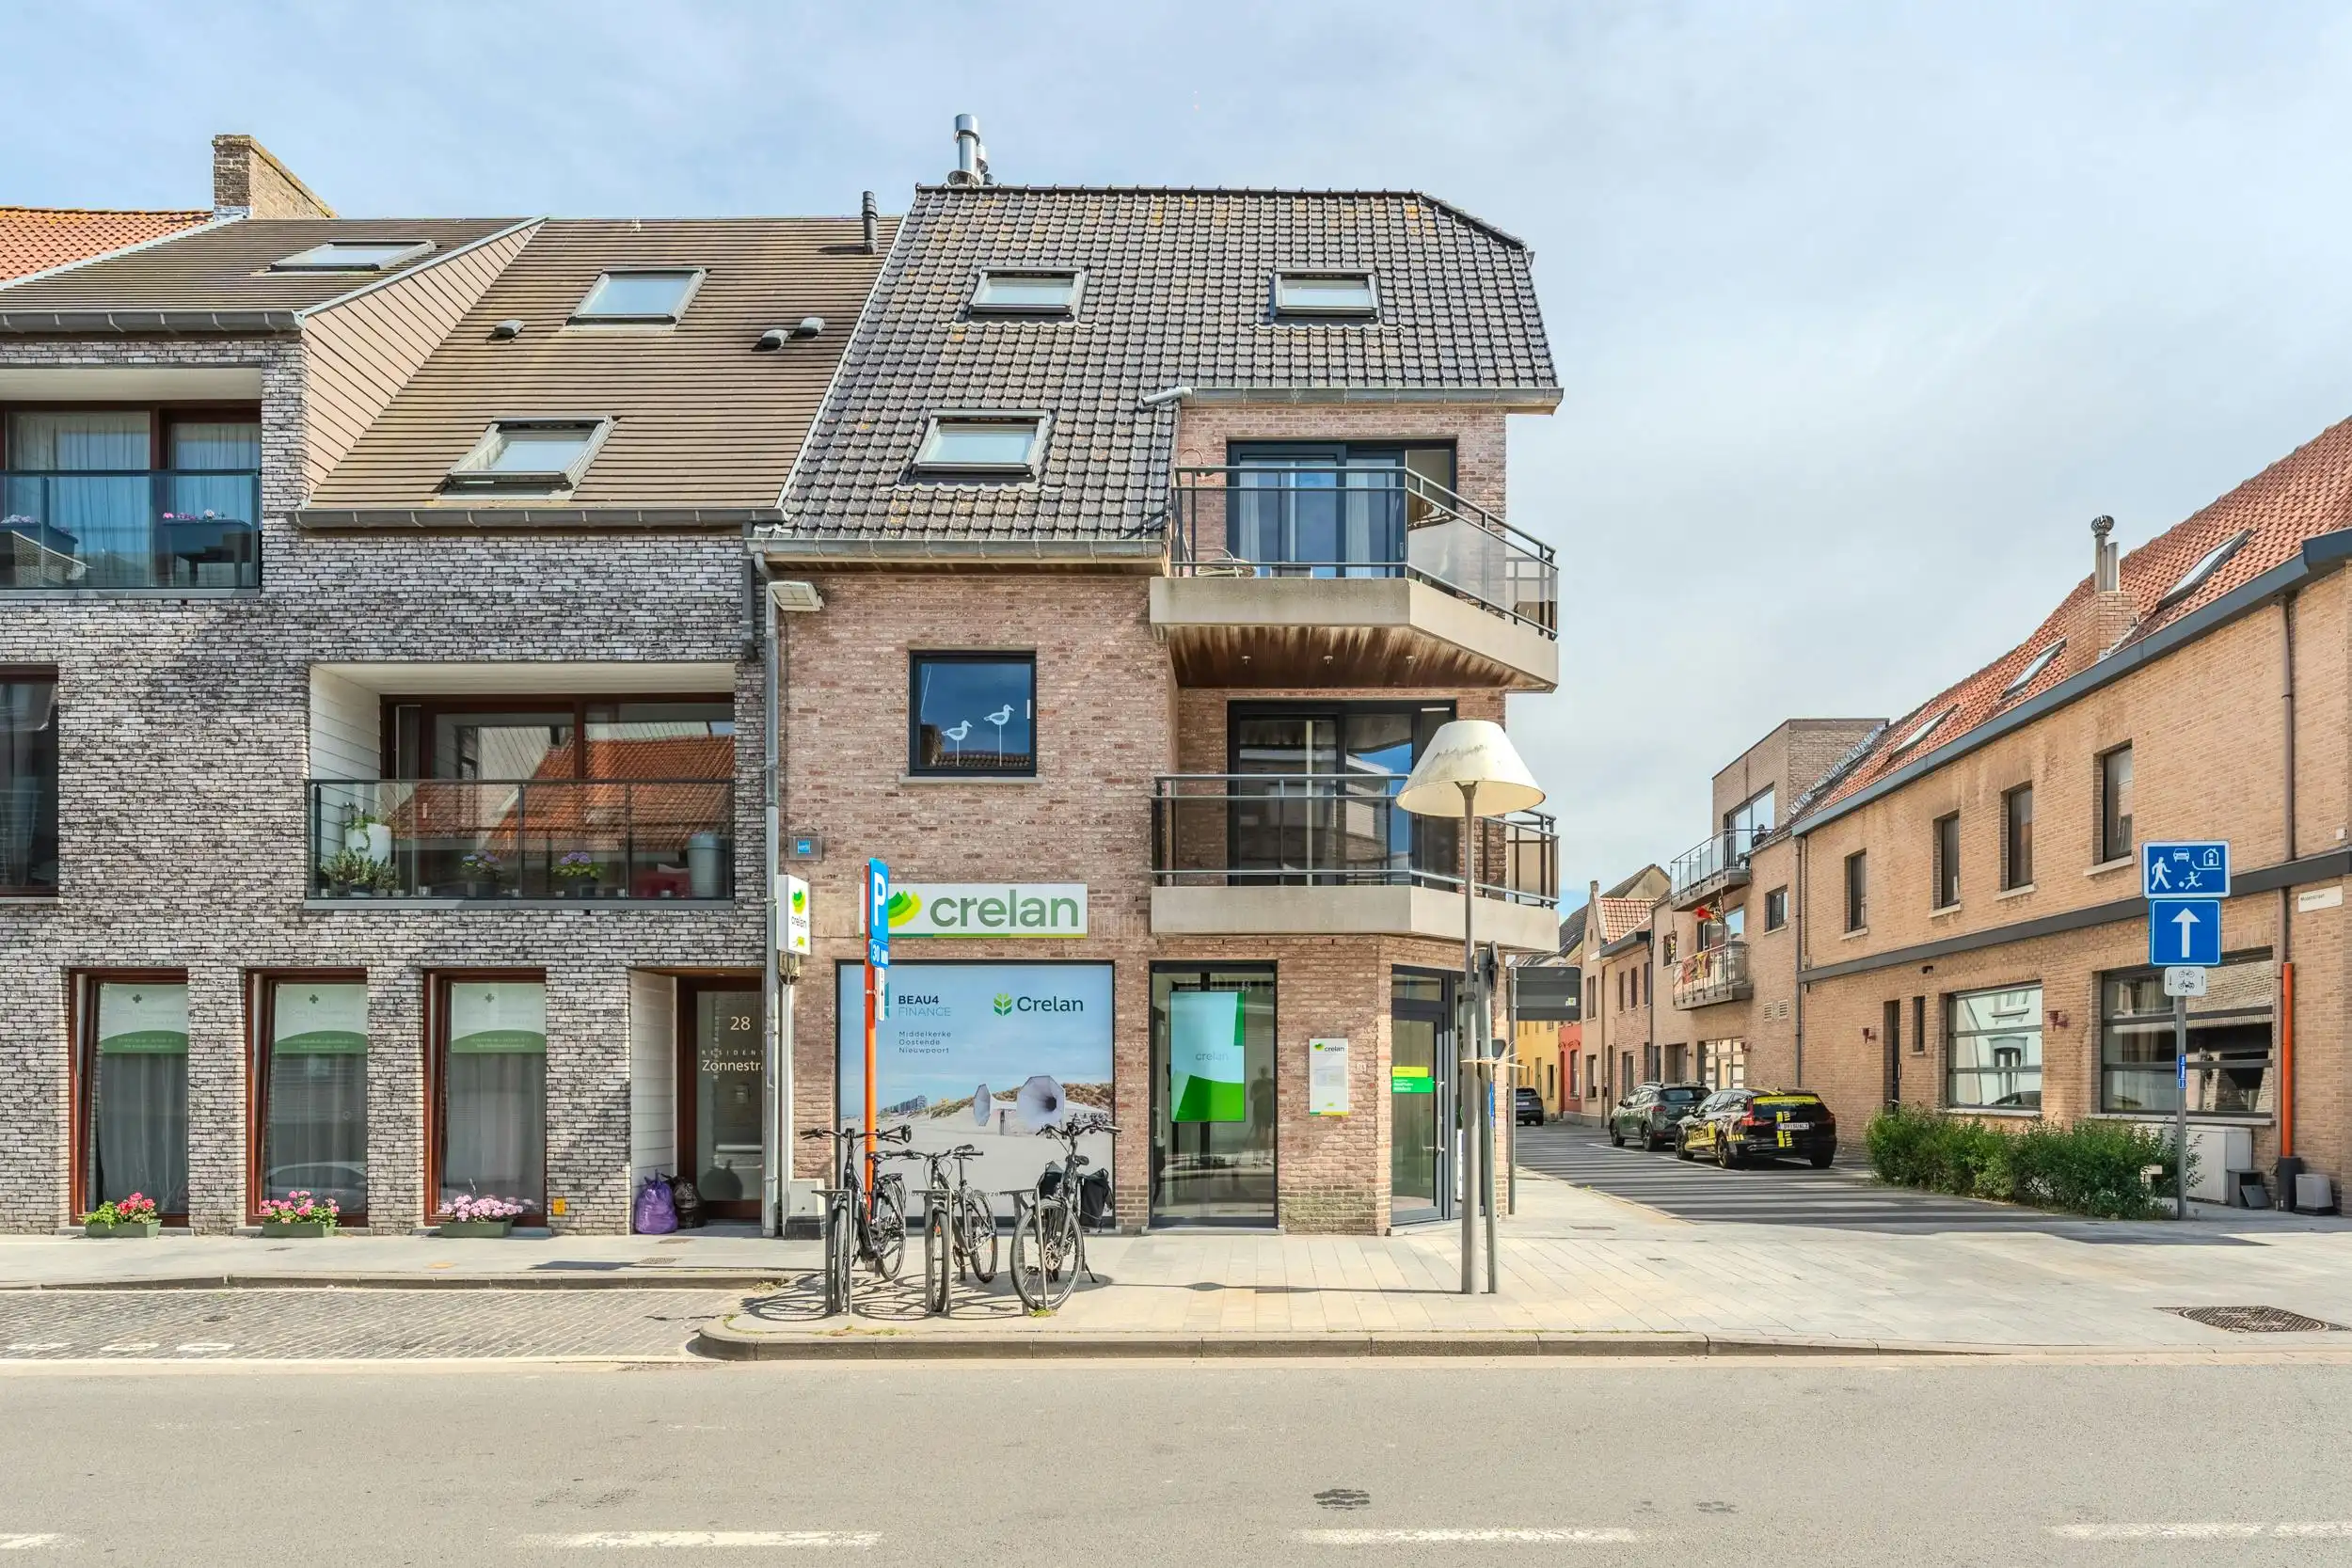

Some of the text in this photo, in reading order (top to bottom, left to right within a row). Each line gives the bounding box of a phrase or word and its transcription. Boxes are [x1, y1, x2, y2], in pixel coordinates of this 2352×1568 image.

[874, 871, 887, 927] P
[930, 889, 1079, 927] crelan
[791, 915, 807, 929] crelan
[873, 943, 880, 962] 30
[898, 995, 940, 1005] BEAU4
[1017, 995, 1084, 1012] Crelan
[898, 1006, 951, 1017] FINANCE
[730, 1016, 751, 1031] 28
[1195, 1051, 1229, 1061] crelan
